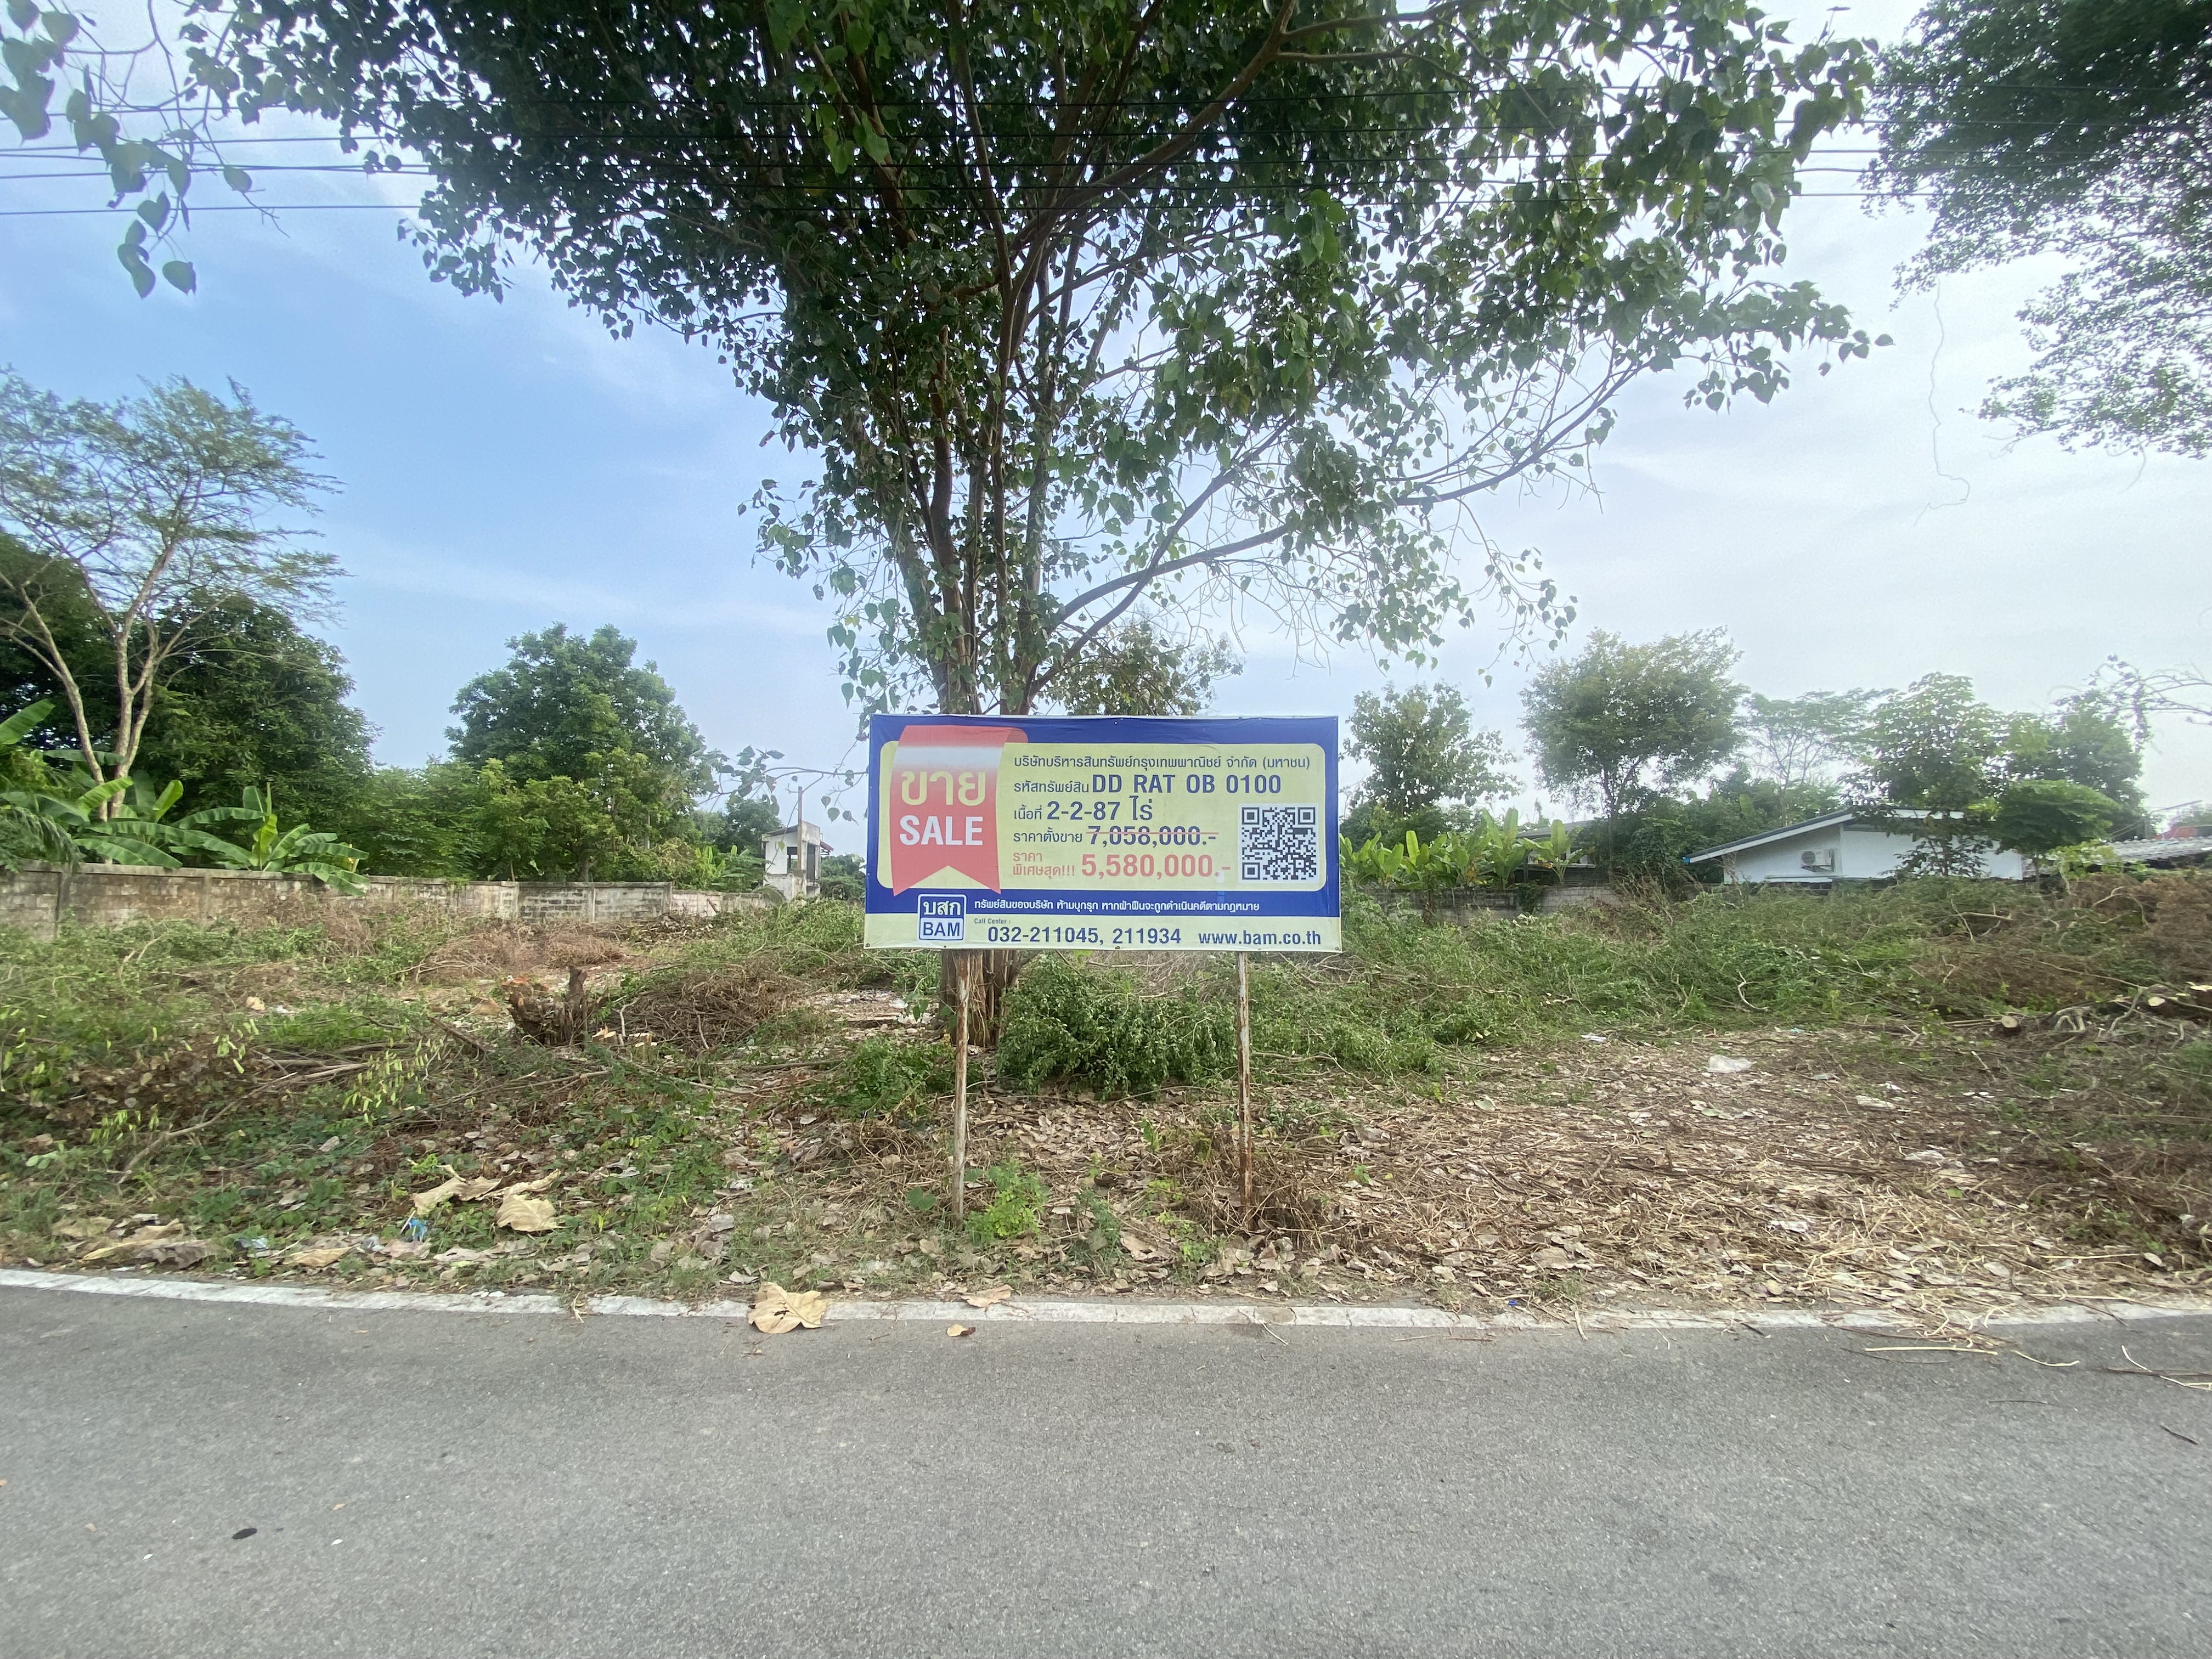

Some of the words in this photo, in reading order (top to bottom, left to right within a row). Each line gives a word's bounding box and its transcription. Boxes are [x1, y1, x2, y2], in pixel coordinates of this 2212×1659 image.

[1014, 755, 1222, 771] บริษัทบริหารสินทรัพย์กรุงเทพพาณิชย์
[1226, 755, 1257, 768] จำกัด
[1262, 756, 1310, 770] (มหาชน)
[901, 771, 986, 806] ขาย
[1014, 780, 1090, 793] รหัสทรัพย์สิน
[1092, 774, 1122, 793] DD
[1133, 774, 1176, 794] RAT
[1226, 774, 1282, 794] 0100
[1014, 804, 1042, 820] เนื้อที่
[1047, 800, 1121, 821] 2-2-87
[1128, 795, 1153, 821] ไร่
[899, 815, 984, 846] SALE
[1013, 827, 1083, 843] ราคาตั้งขาย
[1087, 825, 1216, 848] 7,058,000.-
[1013, 852, 1042, 862] ราคา
[1012, 864, 1076, 879] พิเศษสุด!!!
[1081, 854, 1231, 880] 5,580,000.-
[923, 900, 961, 916] บสก
[974, 899, 1054, 910] ทรัพย์สินของบริษัท
[1057, 900, 1098, 913] ห้ามบุกรุก
[923, 922, 960, 937] BAM
[988, 926, 1104, 945] 032-211045,
[1112, 928, 1182, 944] 211934
[1198, 930, 1322, 945] www.bam.co.th
